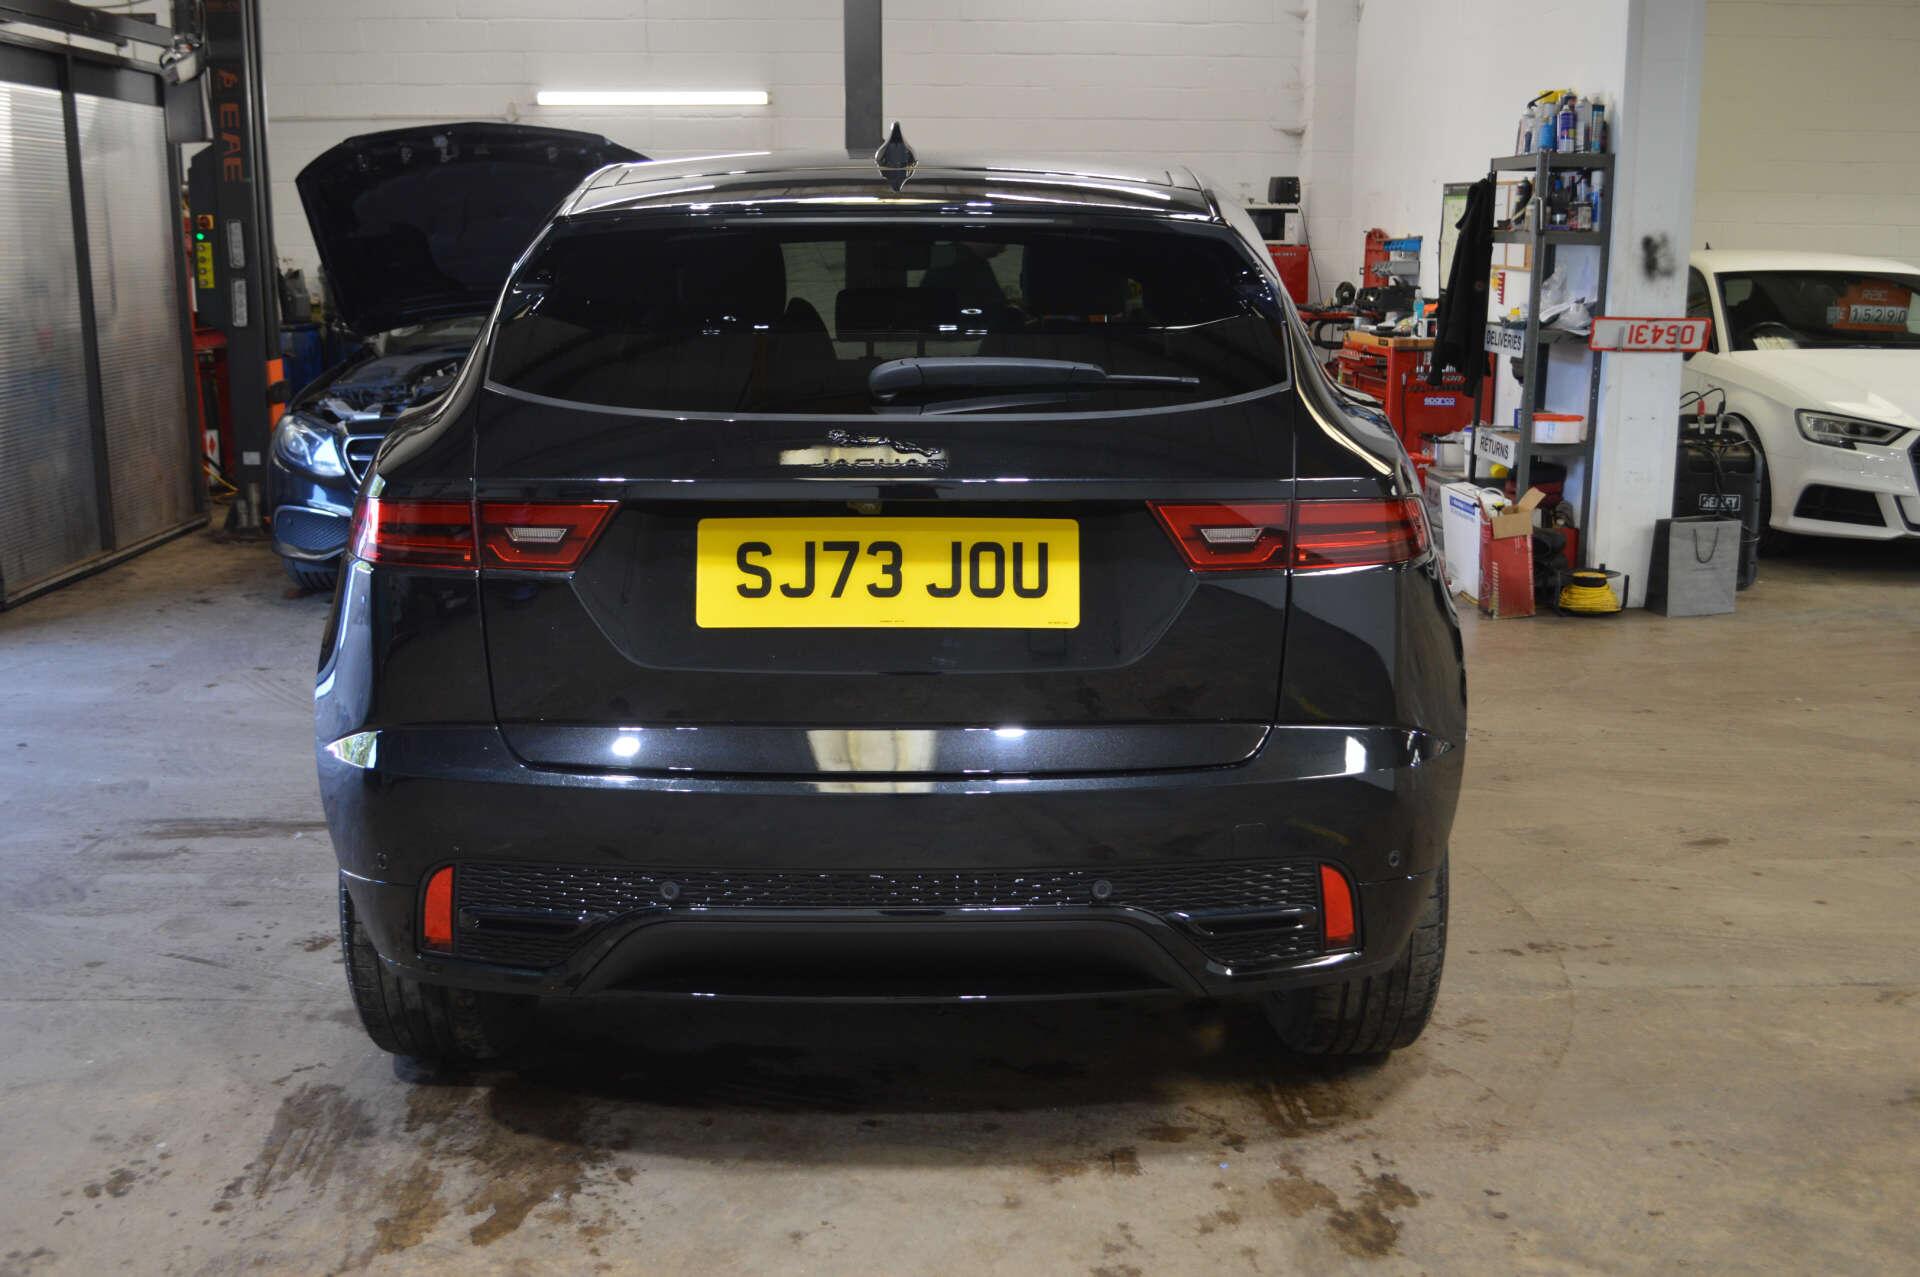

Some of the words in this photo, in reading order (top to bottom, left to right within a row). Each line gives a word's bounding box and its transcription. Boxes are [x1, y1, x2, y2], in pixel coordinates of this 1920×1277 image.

[219, 102, 243, 183] EAE
[1486, 329, 1522, 351] DELIVERIES
[1480, 435, 1509, 460] RETURNS
[736, 541, 903, 598] SJ73
